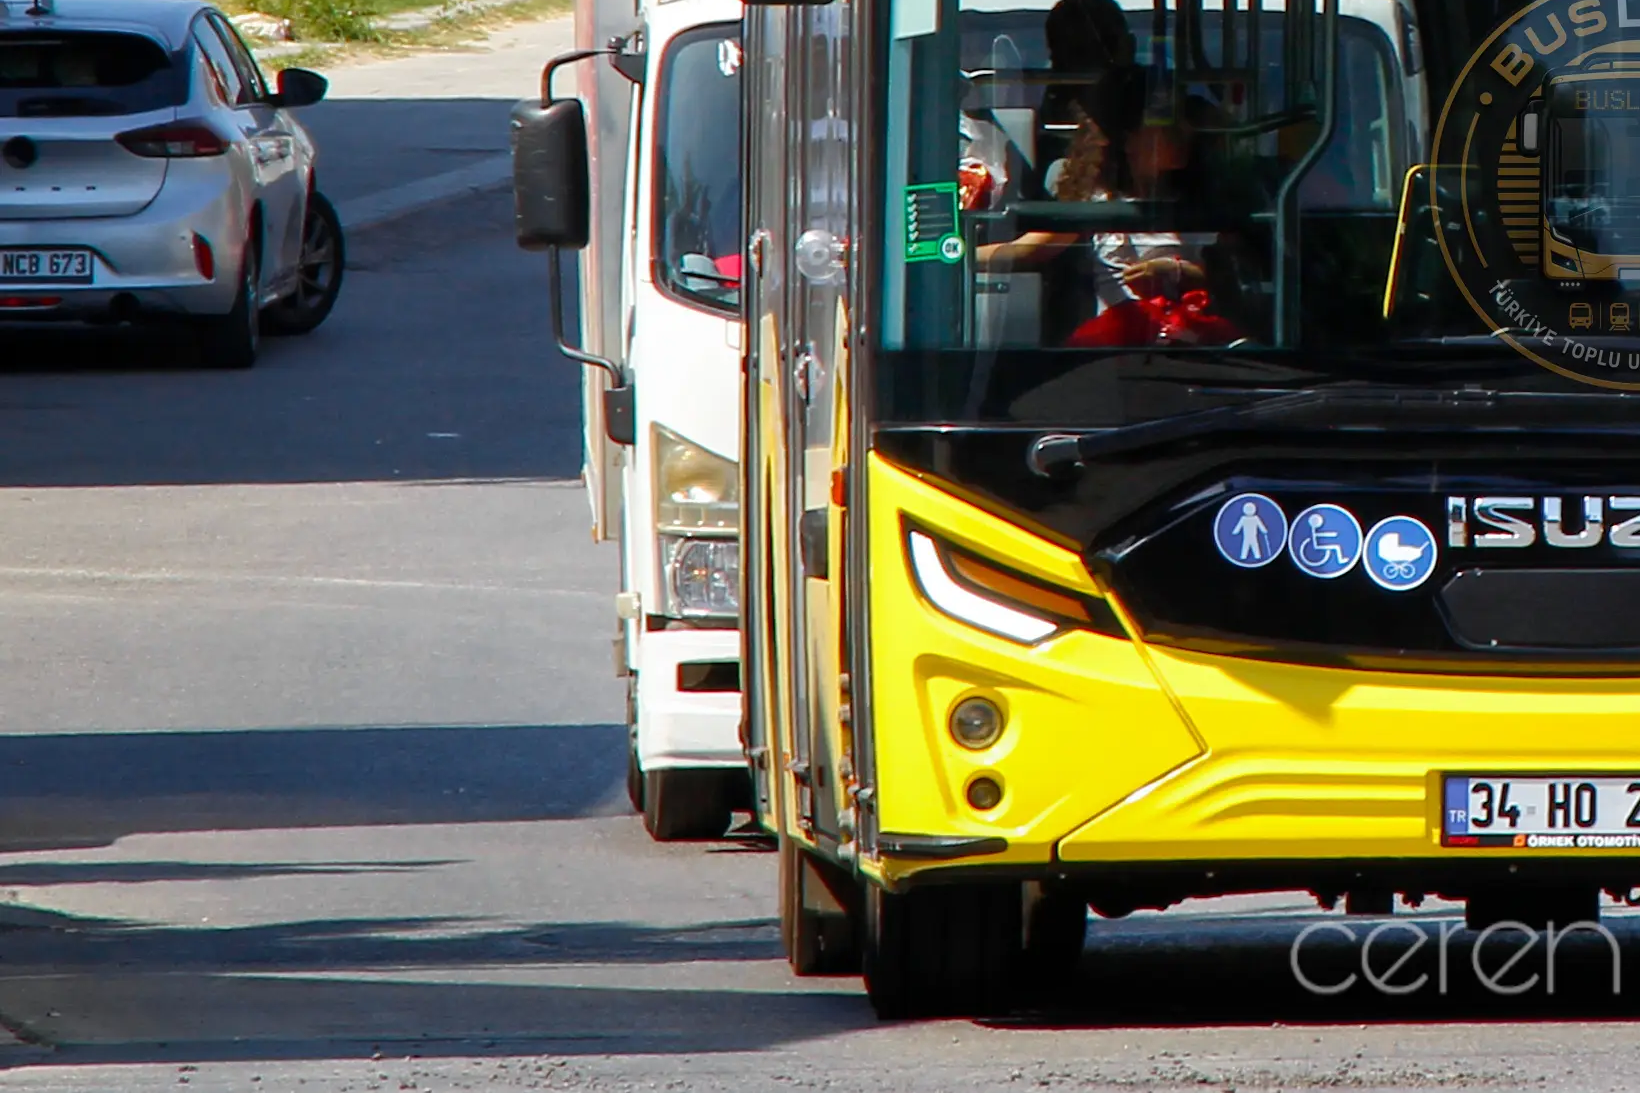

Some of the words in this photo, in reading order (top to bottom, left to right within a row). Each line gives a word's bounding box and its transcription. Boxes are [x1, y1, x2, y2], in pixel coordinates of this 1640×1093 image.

[3, 253, 40, 274] NCB
[49, 253, 87, 274] 673
[1471, 782, 1520, 828] 34
[1449, 810, 1467, 823] TR
[1527, 835, 1575, 847] ÖRNEK
